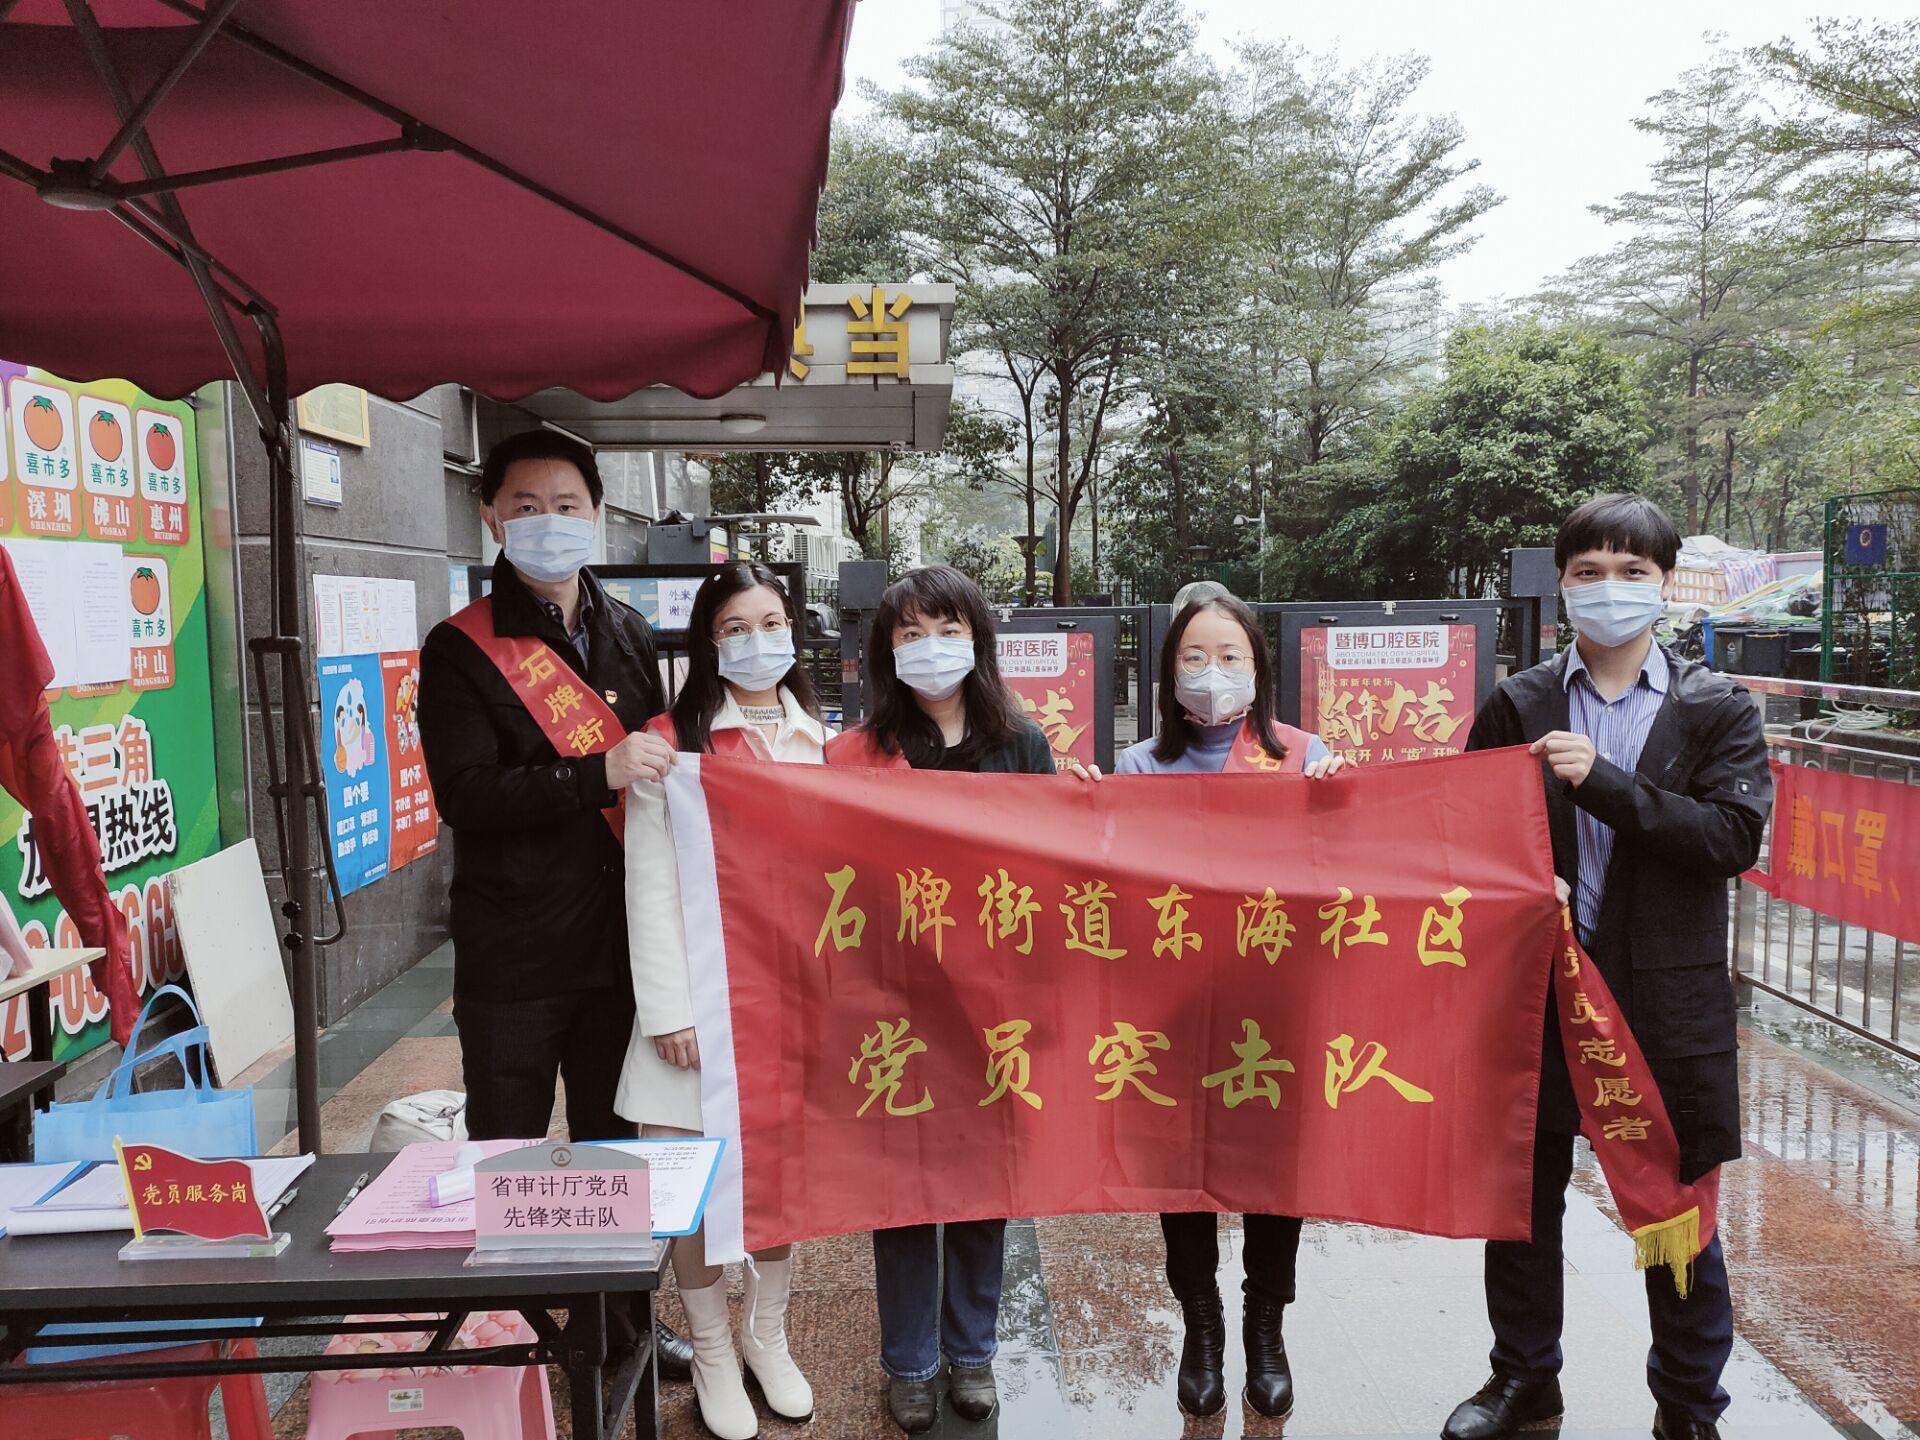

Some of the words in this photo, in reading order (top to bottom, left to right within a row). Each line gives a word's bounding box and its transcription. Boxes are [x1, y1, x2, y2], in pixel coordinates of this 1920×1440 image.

[26, 451, 71, 480] 喜市多
[91, 463, 130, 489] 喜市多
[147, 472, 182, 495] 喜市多
[27, 489, 73, 524] 深圳
[93, 497, 131, 528] 佛山
[150, 503, 184, 532] 惠州
[30, 520, 72, 533] SHENZHEN
[100, 526, 128, 538] FOSHAN
[669, 589, 694, 601] 外来
[131, 618, 166, 638] 喜市多
[1334, 631, 1440, 649] 暨博口腔医院
[134, 650, 168, 677] 中山
[133, 675, 170, 687] ZHONGSHAN
[519, 644, 605, 756] 石牌街
[1381, 748, 1394, 761] 从
[814, 864, 1473, 967] 石牌街道东海社区
[848, 1017, 1434, 1118] 党员突击队
[142, 1181, 247, 1206] 党员服务岗
[491, 1174, 630, 1198] 省审计厅党员
[503, 1205, 620, 1229] 先锋突击队
